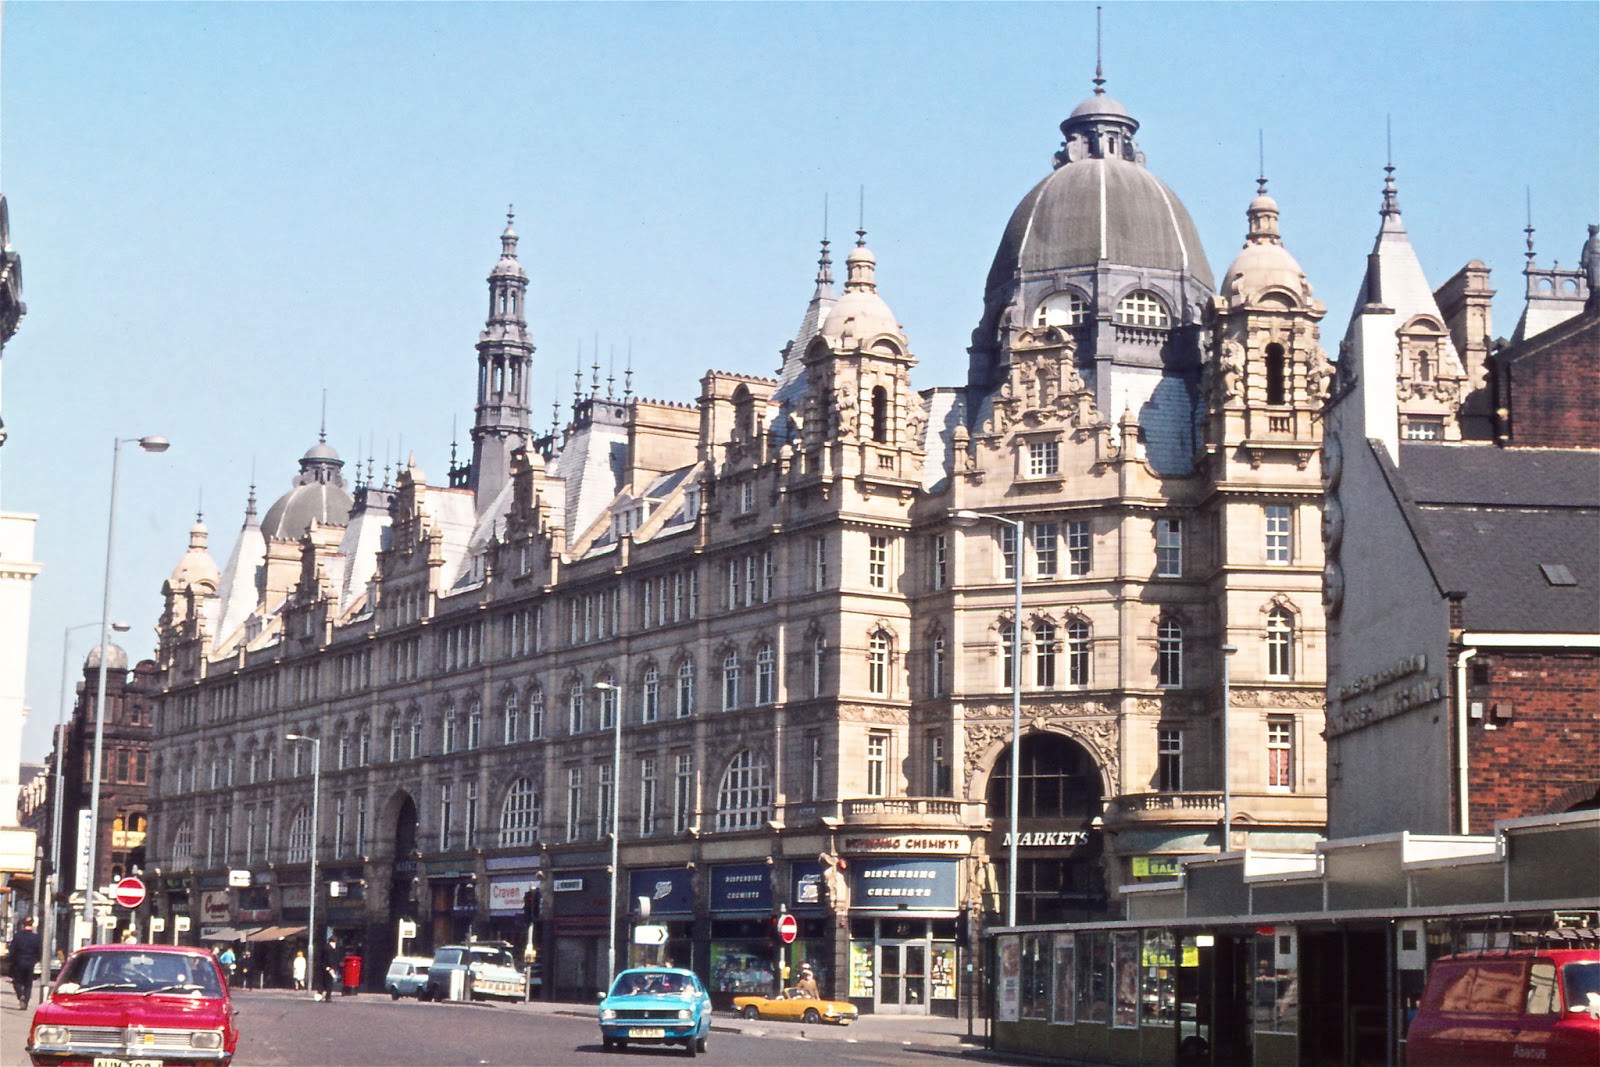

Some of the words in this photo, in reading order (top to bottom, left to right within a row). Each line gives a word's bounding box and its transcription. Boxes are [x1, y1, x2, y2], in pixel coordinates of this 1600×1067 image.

[1002, 831, 1089, 847] MARKETS
[863, 870, 937, 879] DISPENSING
[867, 888, 932, 897] CHEMISTS
